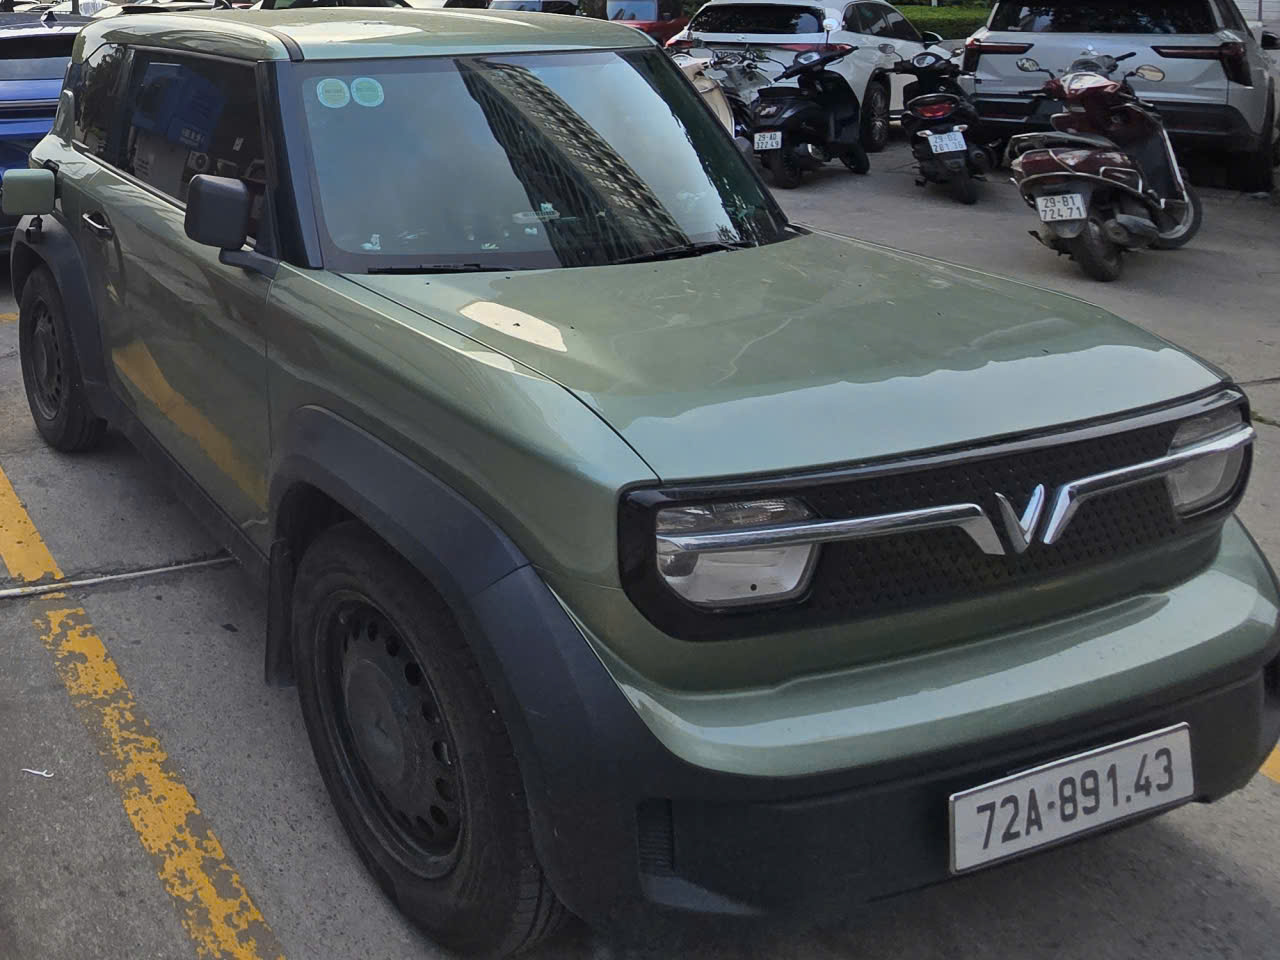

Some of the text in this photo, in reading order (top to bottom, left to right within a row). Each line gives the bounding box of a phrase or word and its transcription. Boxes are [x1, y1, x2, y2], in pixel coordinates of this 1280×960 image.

[1042, 195, 1076, 209] 29-B1
[1041, 206, 1083, 220] 724.71
[976, 747, 1174, 850] 72A-891.43
